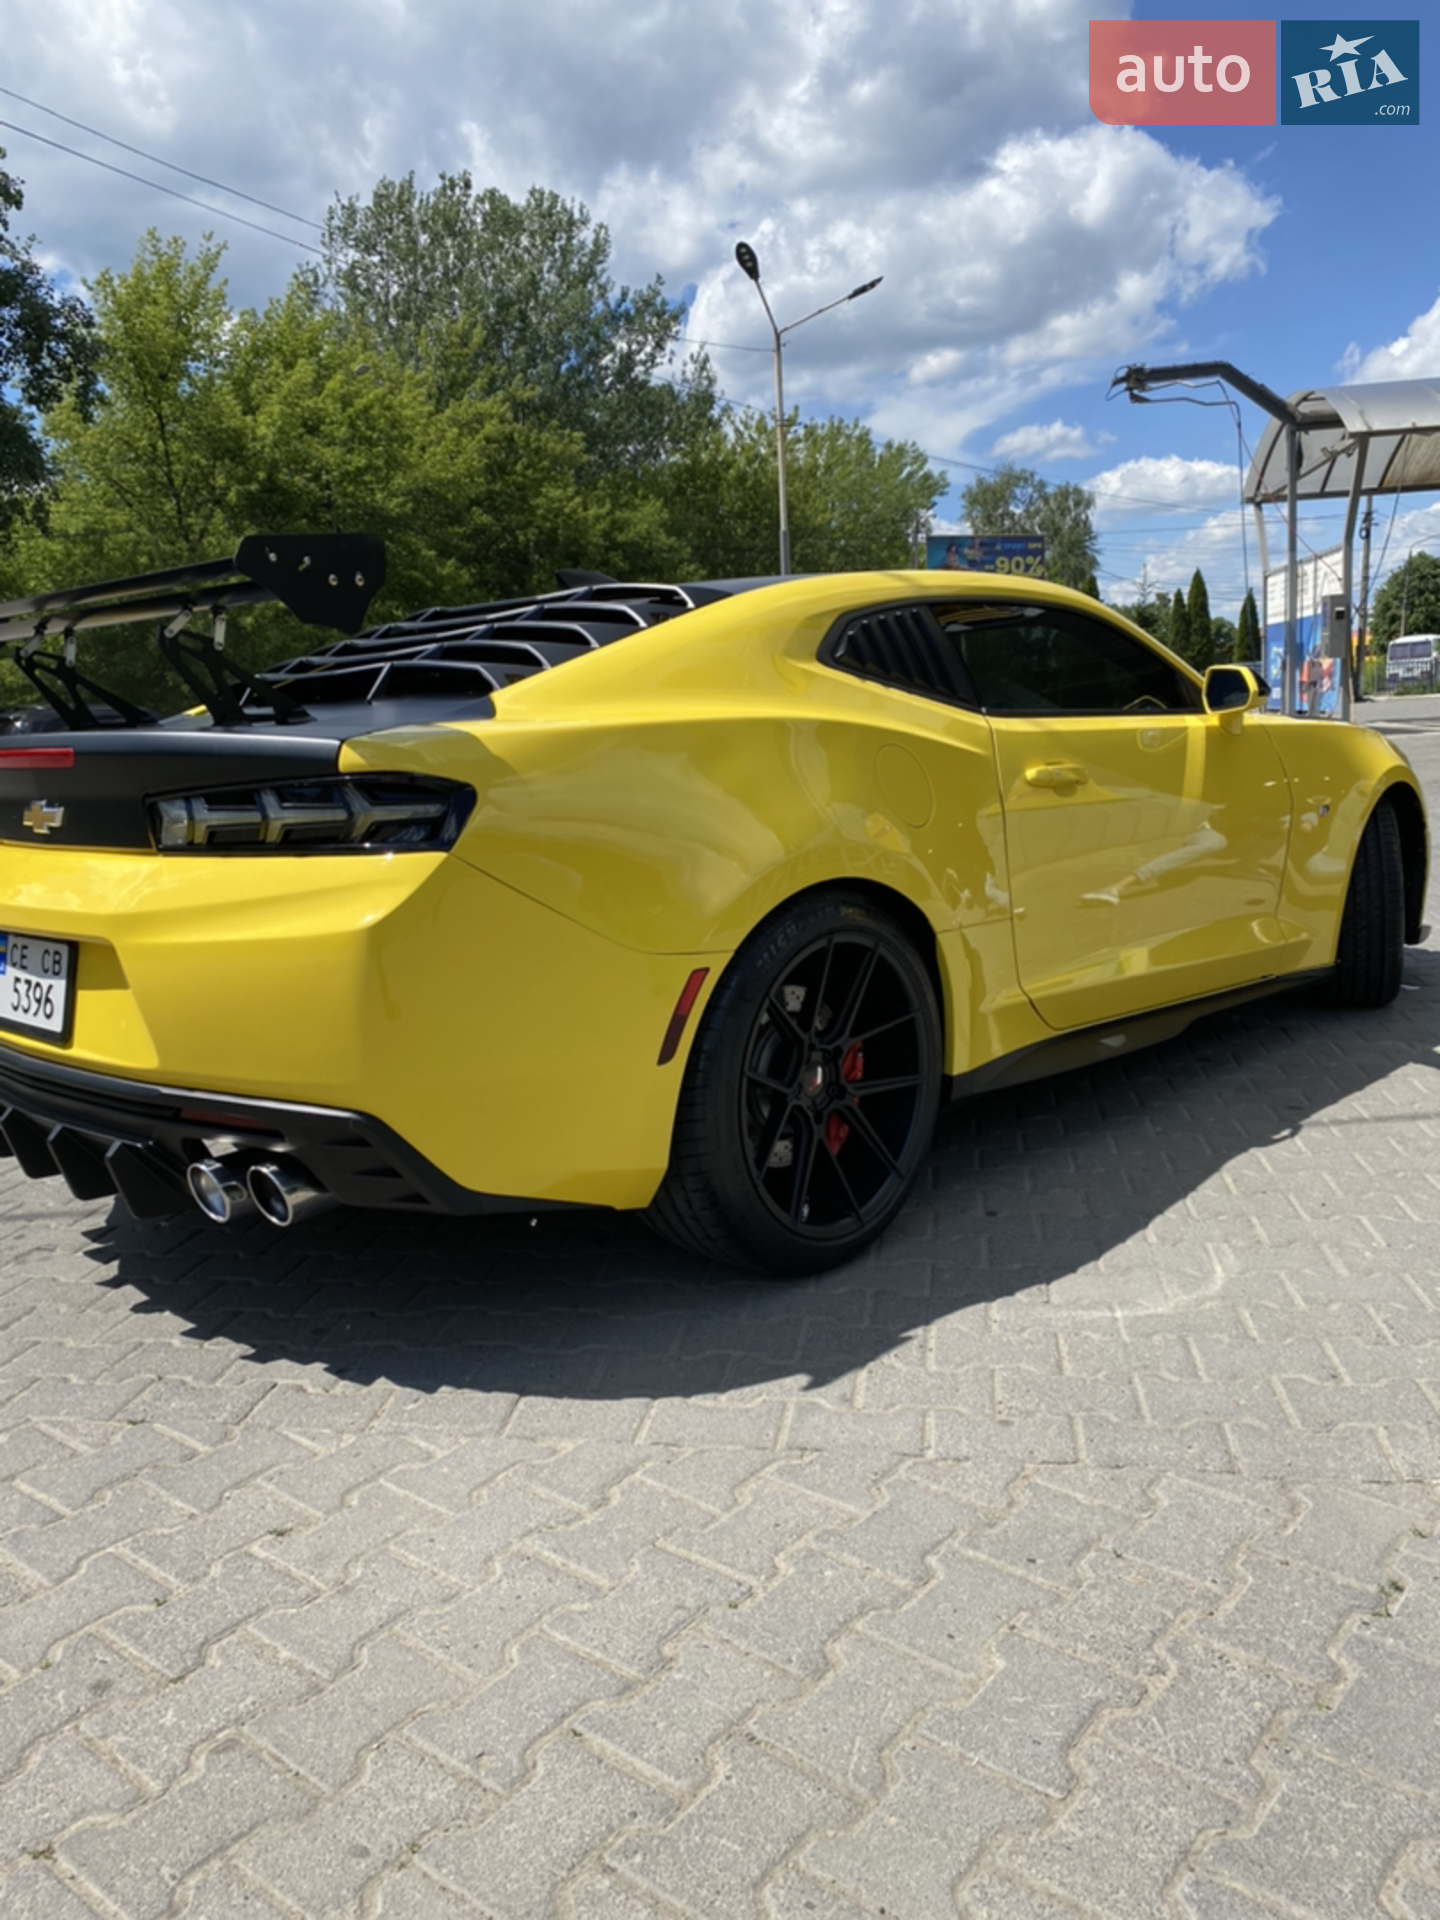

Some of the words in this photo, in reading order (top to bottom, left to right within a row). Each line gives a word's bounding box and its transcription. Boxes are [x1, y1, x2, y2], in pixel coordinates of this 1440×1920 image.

[10, 943, 28, 970] CE
[41, 949, 63, 976] CB
[11, 976, 54, 1020] 5396
